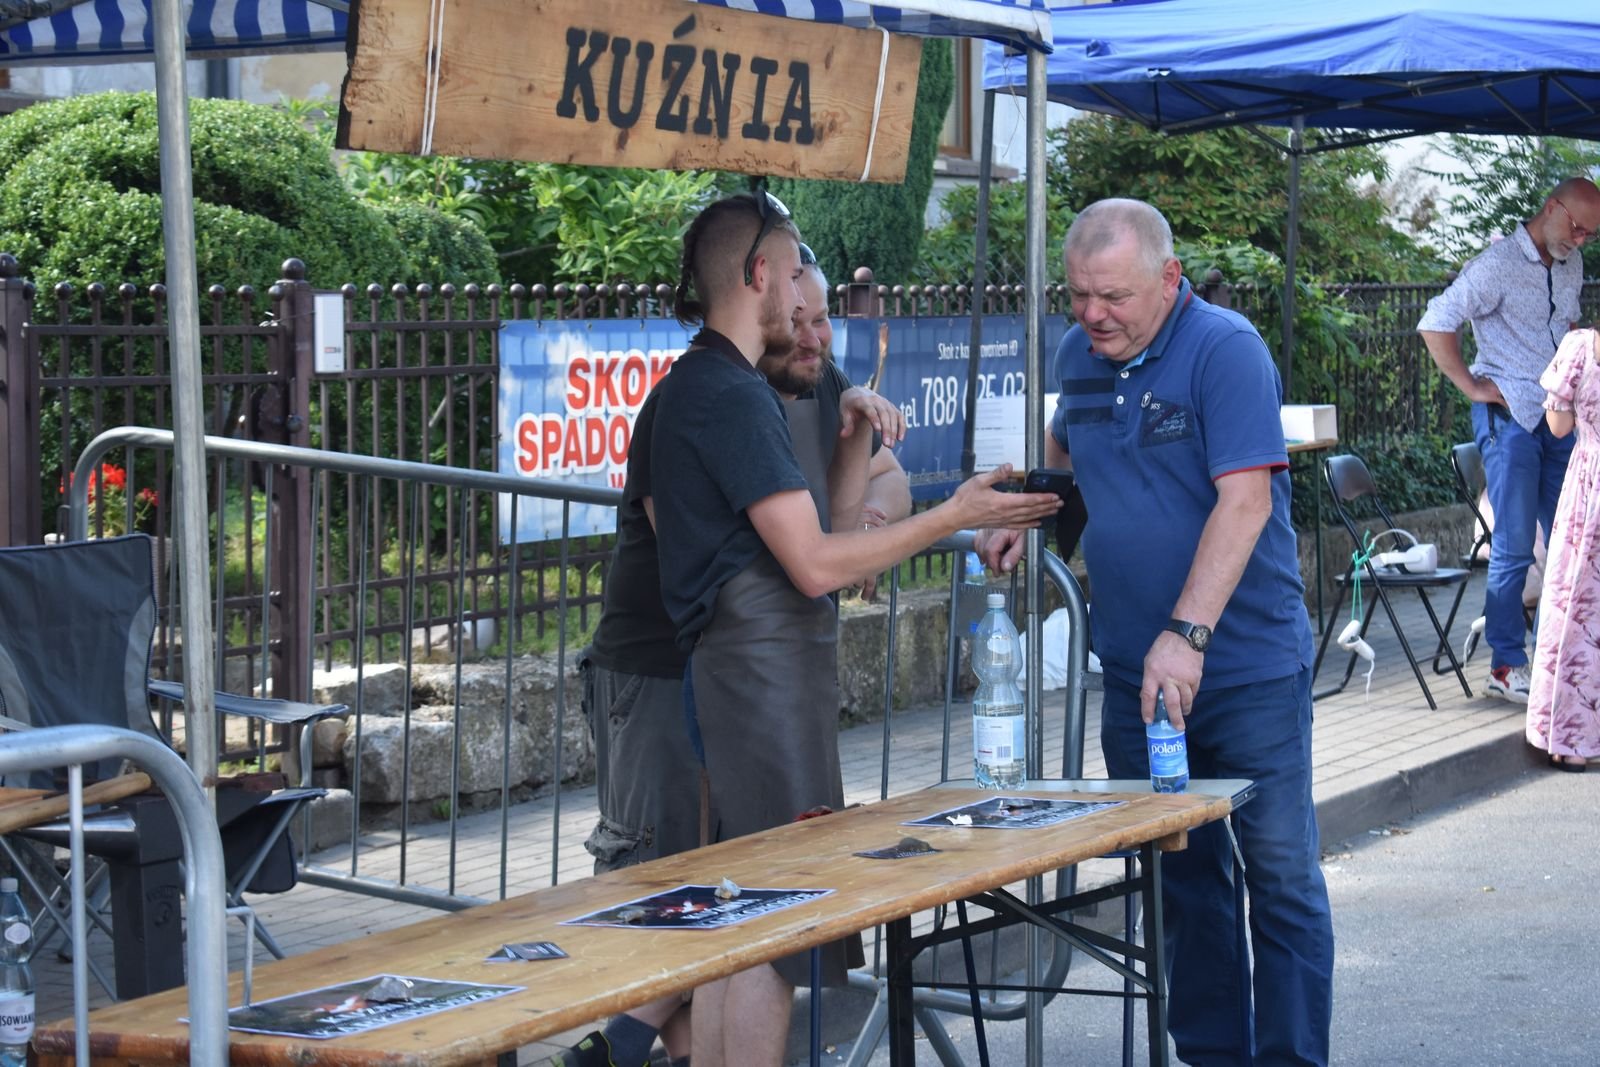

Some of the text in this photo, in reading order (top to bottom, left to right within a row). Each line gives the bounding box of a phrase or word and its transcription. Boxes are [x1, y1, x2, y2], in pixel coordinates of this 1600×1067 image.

[556, 13, 815, 145] KUŹNIA
[567, 356, 675, 410] SKOK
[921, 375, 959, 427] 788
[518, 415, 631, 473] SPADO
[1151, 740, 1184, 756] polaris
